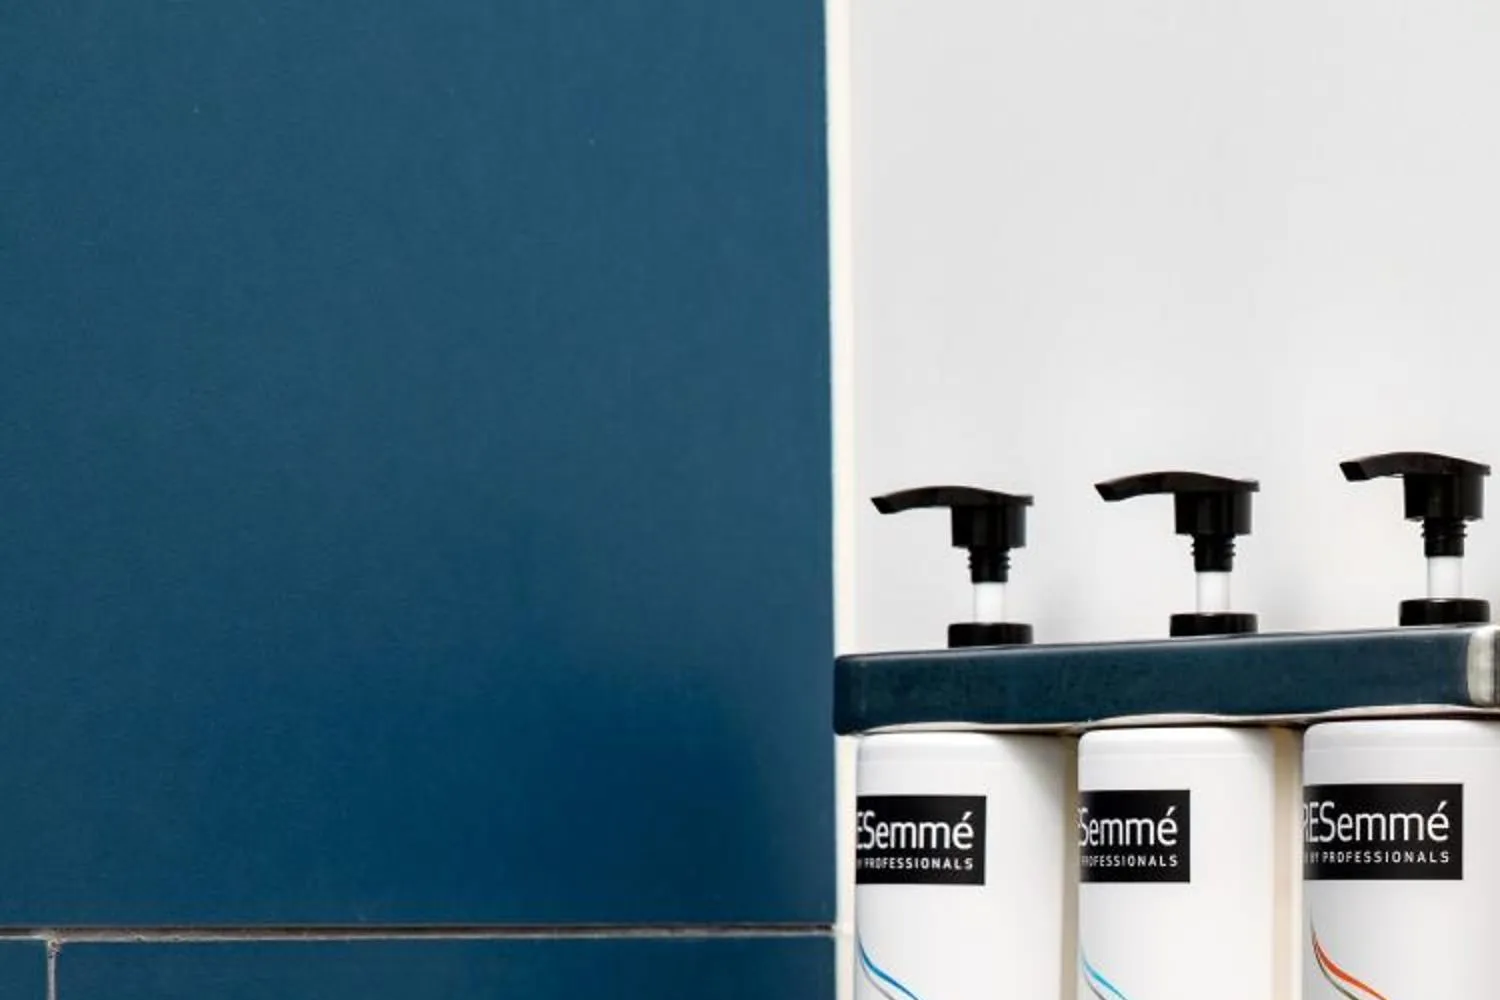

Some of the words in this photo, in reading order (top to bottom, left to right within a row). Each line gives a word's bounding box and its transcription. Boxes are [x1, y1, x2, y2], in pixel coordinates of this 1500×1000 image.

[1077, 805, 1178, 847] Semmé
[864, 856, 975, 871] PROFESSIONALS
[1322, 850, 1450, 864] PROFESSIONALS
